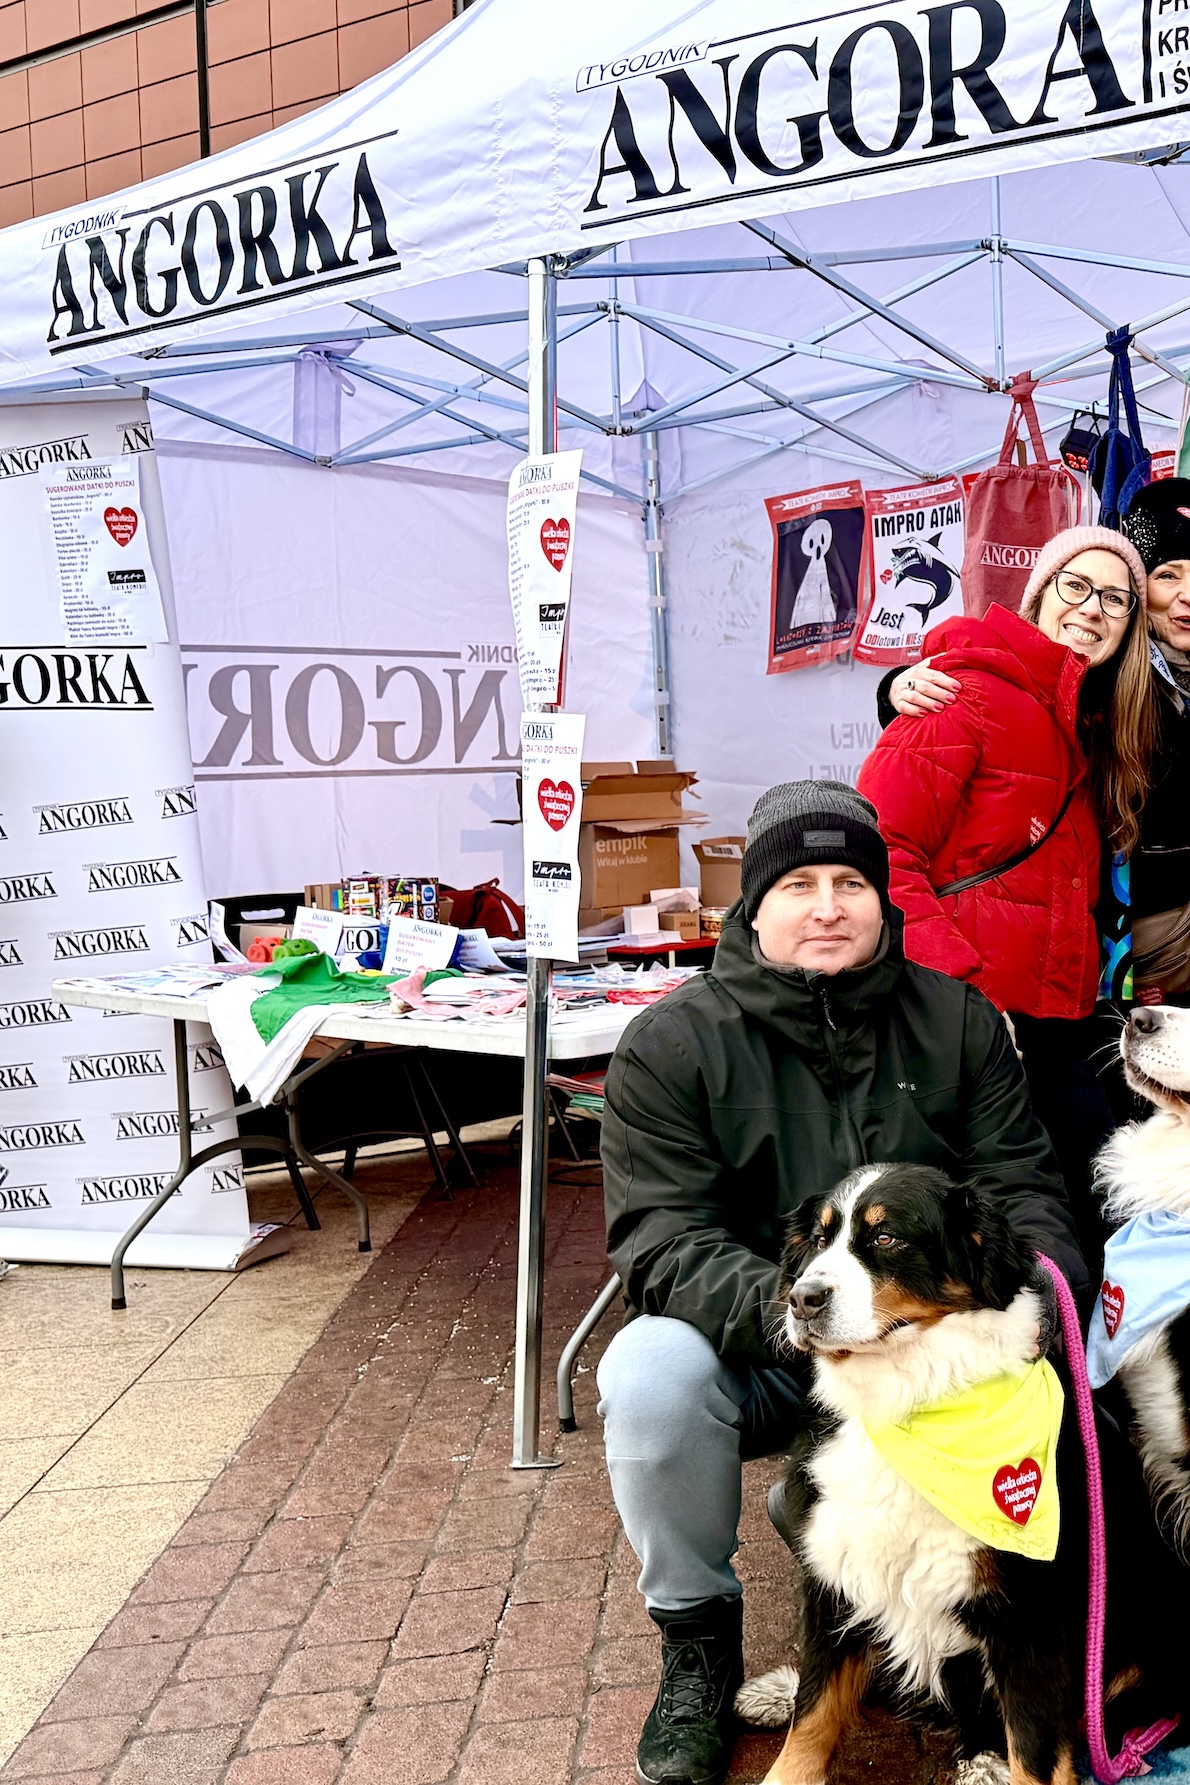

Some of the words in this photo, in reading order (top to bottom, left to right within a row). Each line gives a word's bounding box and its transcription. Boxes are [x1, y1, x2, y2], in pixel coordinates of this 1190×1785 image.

[586, 40, 707, 85] TYGODNIK
[1159, 71, 1166, 98] I
[583, 0, 1136, 212] ANGORA
[49, 209, 120, 246] TYGODNIK
[46, 152, 397, 342] ANGORKA
[66, 467, 112, 482] ANGORKA
[86, 482, 104, 491] DATKI
[105, 481, 114, 489] DO
[874, 512, 925, 538] IMPRO
[930, 501, 962, 529] ATAK
[870, 607, 904, 629] Jest
[544, 745, 553, 753] DO
[39, 801, 133, 832] ANGORKA
[595, 833, 648, 855] empik
[89, 861, 181, 891] ANGORKA
[54, 928, 149, 958] ANGORKA
[412, 925, 442, 937] ANGORKA
[69, 1053, 165, 1081] ANGORKA
[997, 1476, 1016, 1493] wielka
